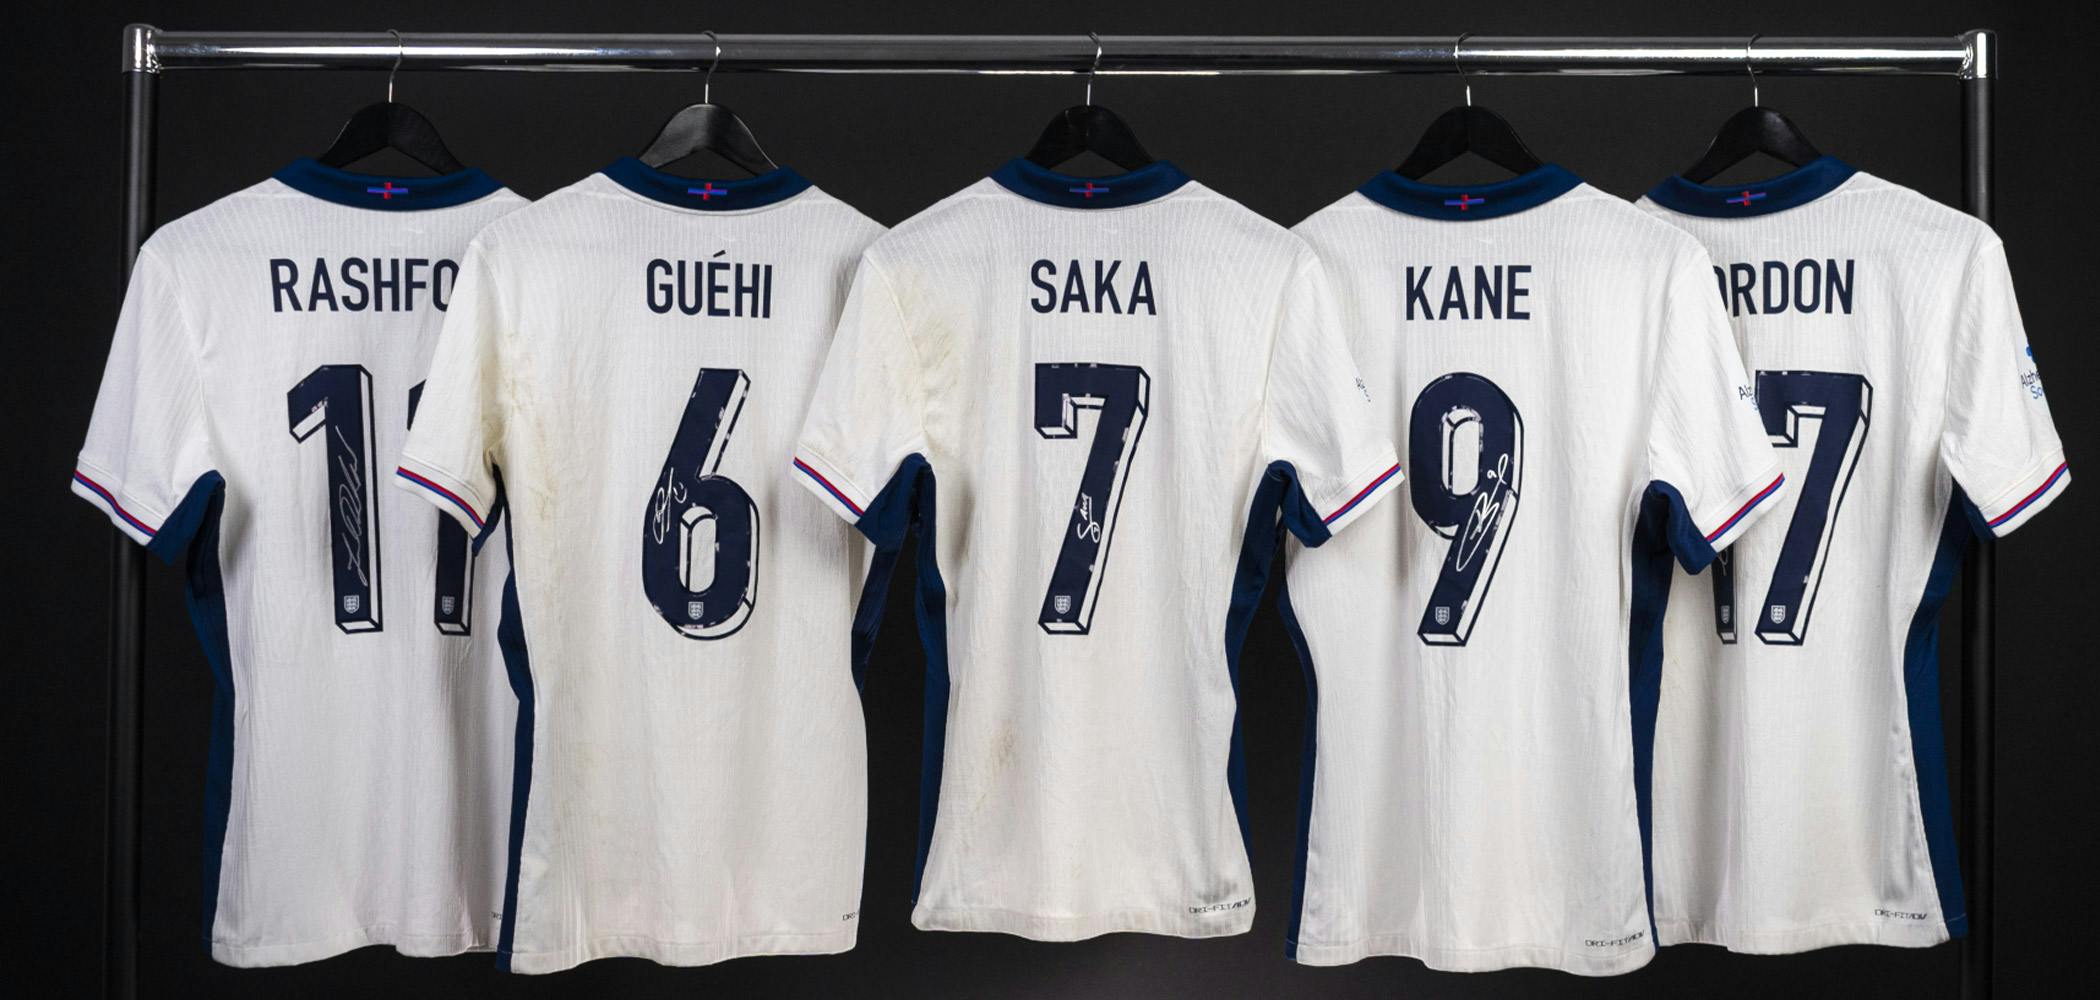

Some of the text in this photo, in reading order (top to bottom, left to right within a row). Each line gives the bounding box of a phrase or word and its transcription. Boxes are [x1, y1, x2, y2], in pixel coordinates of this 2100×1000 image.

[270, 257, 460, 312] RASHFO
[647, 250, 772, 319] GUÉHI
[1031, 259, 1157, 315] SAKA
[1406, 265, 1532, 320] KANE
[642, 367, 760, 641] 6
[1034, 362, 1151, 635] 7
[1408, 371, 1525, 646] 9
